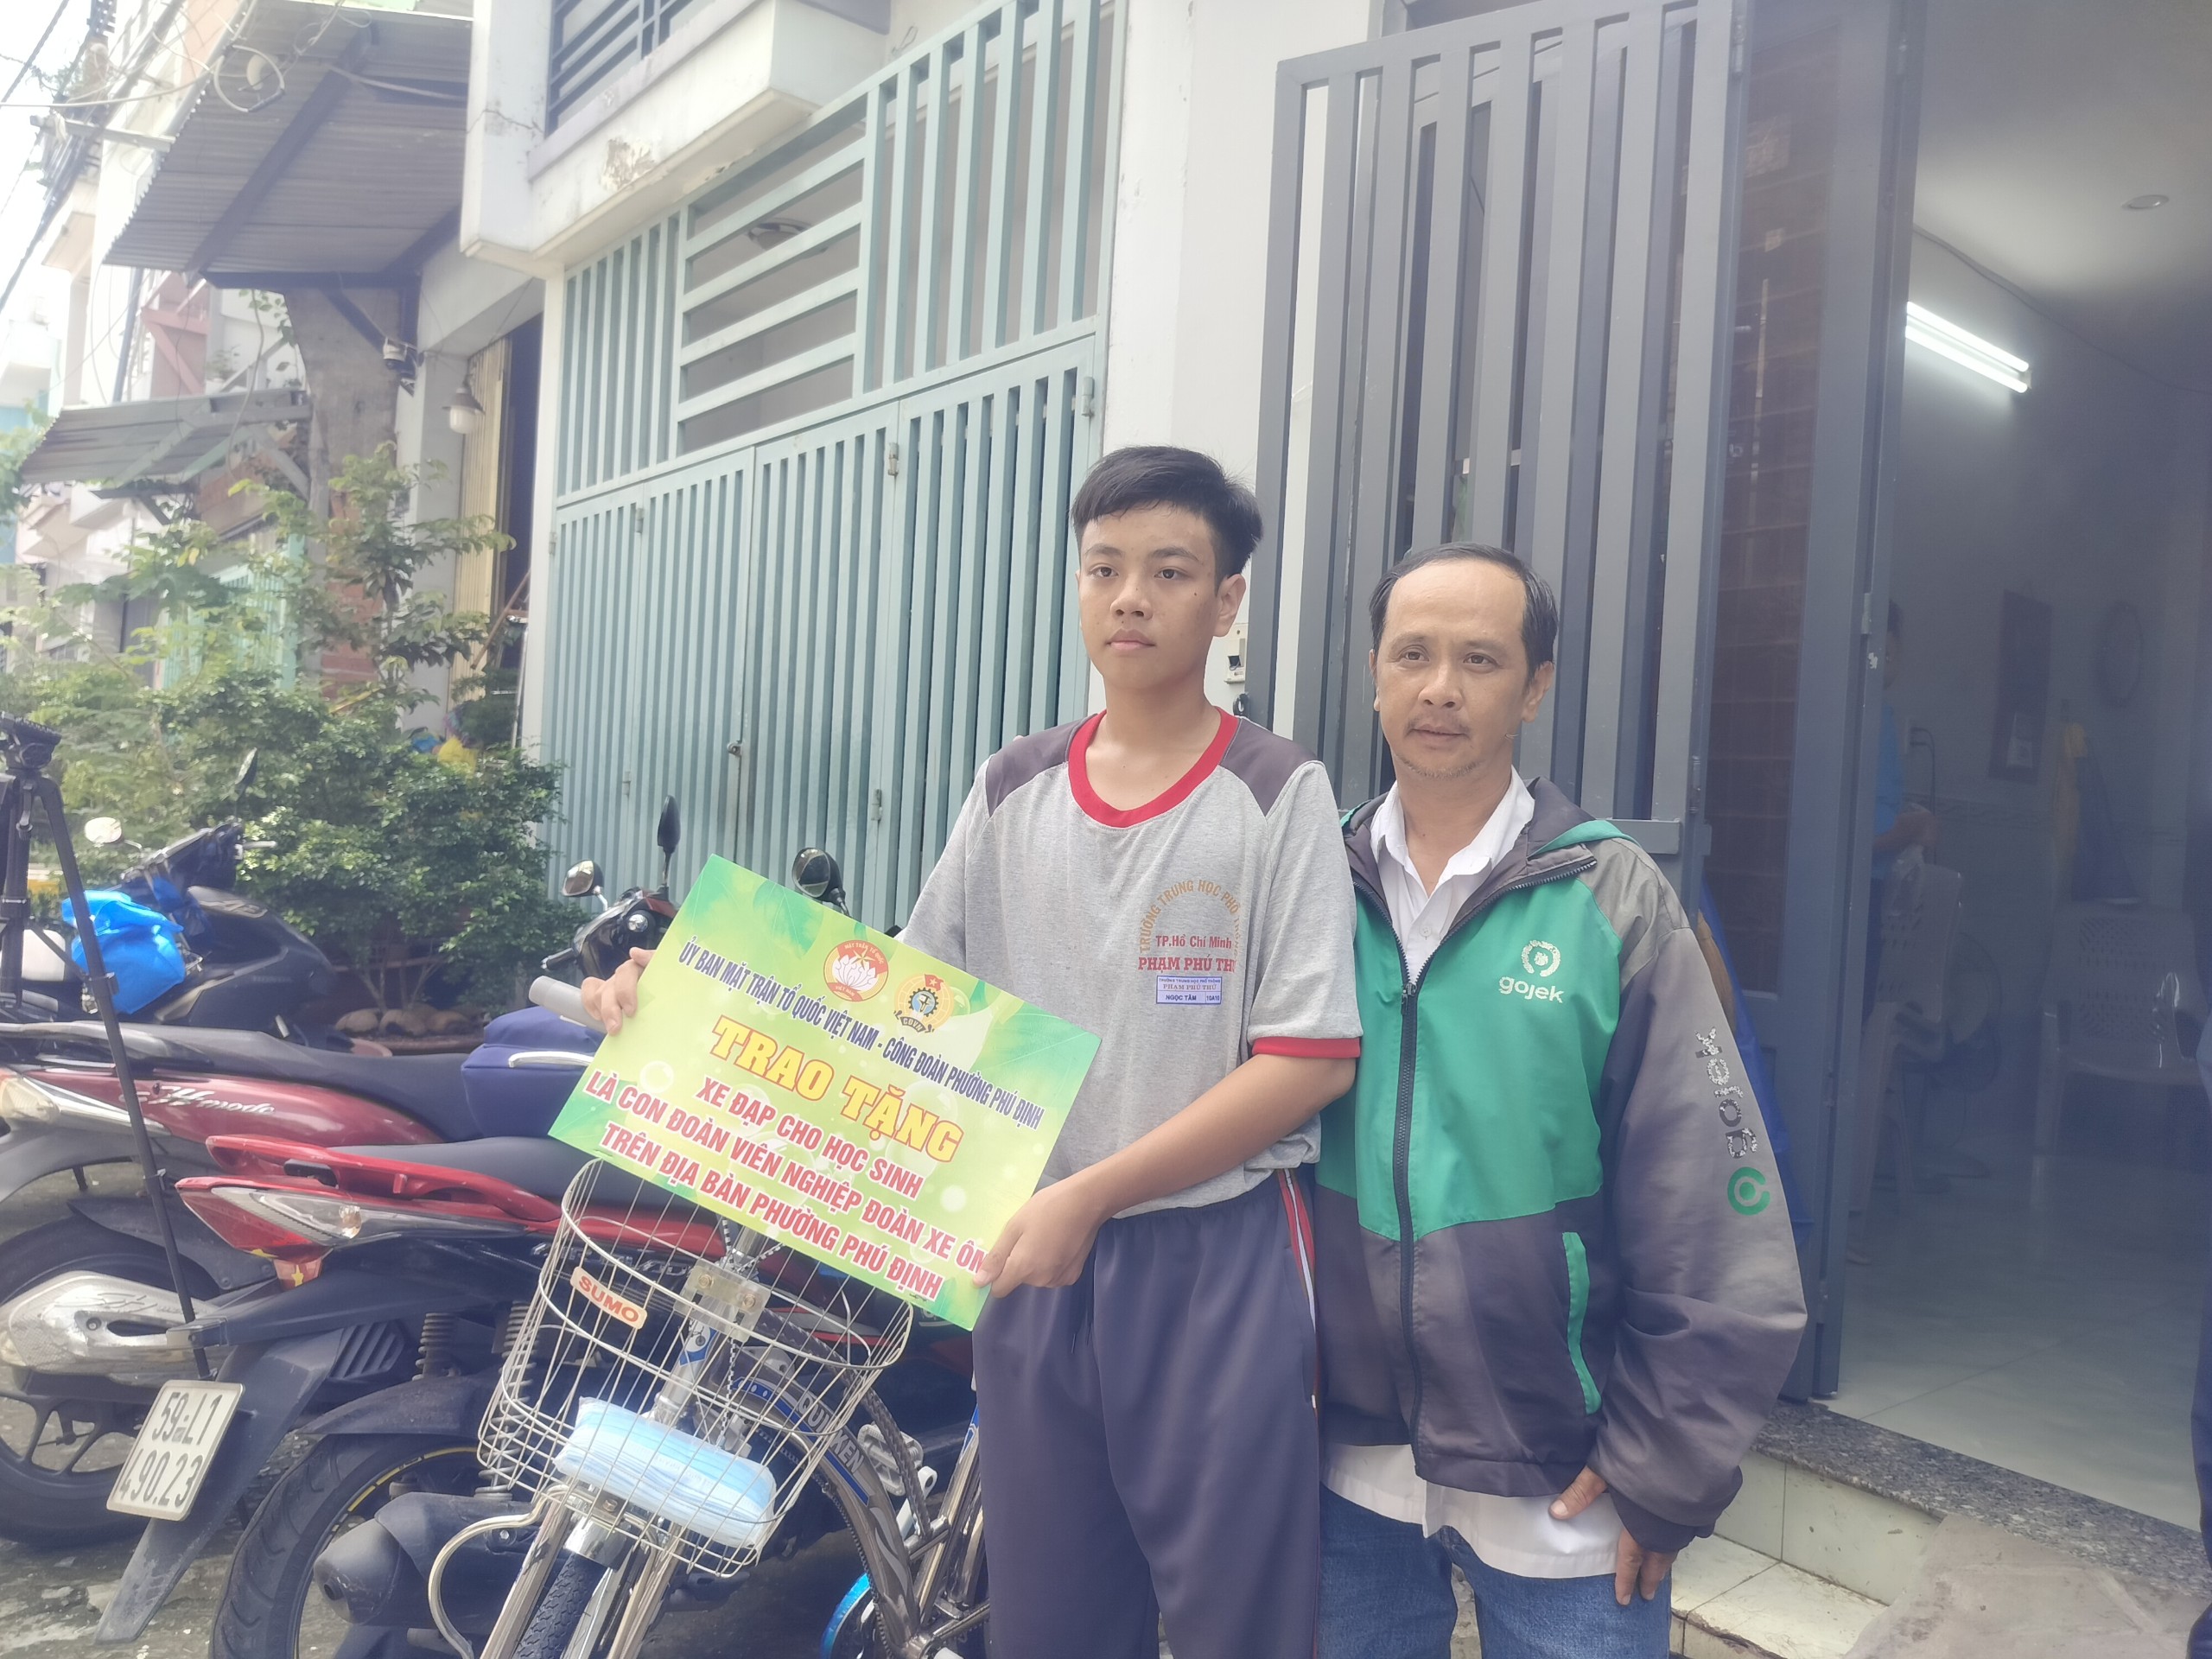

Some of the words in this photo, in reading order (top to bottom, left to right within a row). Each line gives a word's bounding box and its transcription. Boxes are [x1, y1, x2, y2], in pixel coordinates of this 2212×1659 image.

[1157, 880, 1194, 906] TRUNG
[1198, 879, 1222, 896] HỌC
[1138, 957, 1180, 973] PHẠM
[1184, 954, 1212, 970] PHÚ
[1155, 934, 1186, 948] TP.Hồ
[1189, 936, 1207, 948] Chí
[1209, 937, 1232, 950] Minh
[1498, 976, 1565, 1003] gojek
[678, 936, 701, 965] ỦY
[694, 950, 725, 978] BAN
[719, 961, 751, 991] MẶT
[746, 976, 780, 1005] TRẬN
[777, 984, 802, 1011] TỔ
[791, 995, 827, 1026] QUỐC
[823, 1010, 852, 1039] VIỆT
[847, 1020, 880, 1051] NAM
[882, 1037, 918, 1069] CÔNG
[912, 1052, 950, 1084] ĐOÀN
[944, 1066, 994, 1105] PHƯỜNG
[988, 1087, 1019, 1116] PHÚ
[1012, 1098, 1045, 1130] ĐỊNH
[709, 1014, 835, 1102] TRAO
[840, 1075, 964, 1163] TẶNG
[1694, 1027, 1758, 1158] gojek
[585, 1071, 618, 1101] LÀ
[618, 1086, 668, 1123] CON
[665, 1108, 730, 1153] ĐOÀN
[730, 1136, 783, 1178] VIÊN
[781, 1162, 862, 1212] NGHIỆP
[861, 1198, 925, 1244] ĐOÀN
[923, 1228, 955, 1259] XE
[696, 1077, 731, 1108] XE
[728, 1092, 776, 1126] ĐẠP
[777, 1115, 823, 1150] CHO
[822, 1135, 868, 1172] HỌC
[869, 1158, 924, 1199] SINH
[601, 1122, 662, 1166] TRÊN
[658, 1151, 700, 1185] ĐỊA
[700, 1170, 751, 1208] BÀN
[749, 1192, 840, 1250] PHƯỜNG
[839, 1234, 890, 1272] PHÚ
[886, 1256, 944, 1299] ĐỊNH
[579, 1275, 639, 1323] SUMO
[798, 1394, 865, 1474] QUIKEN
[119, 1448, 204, 1508] 490.23
